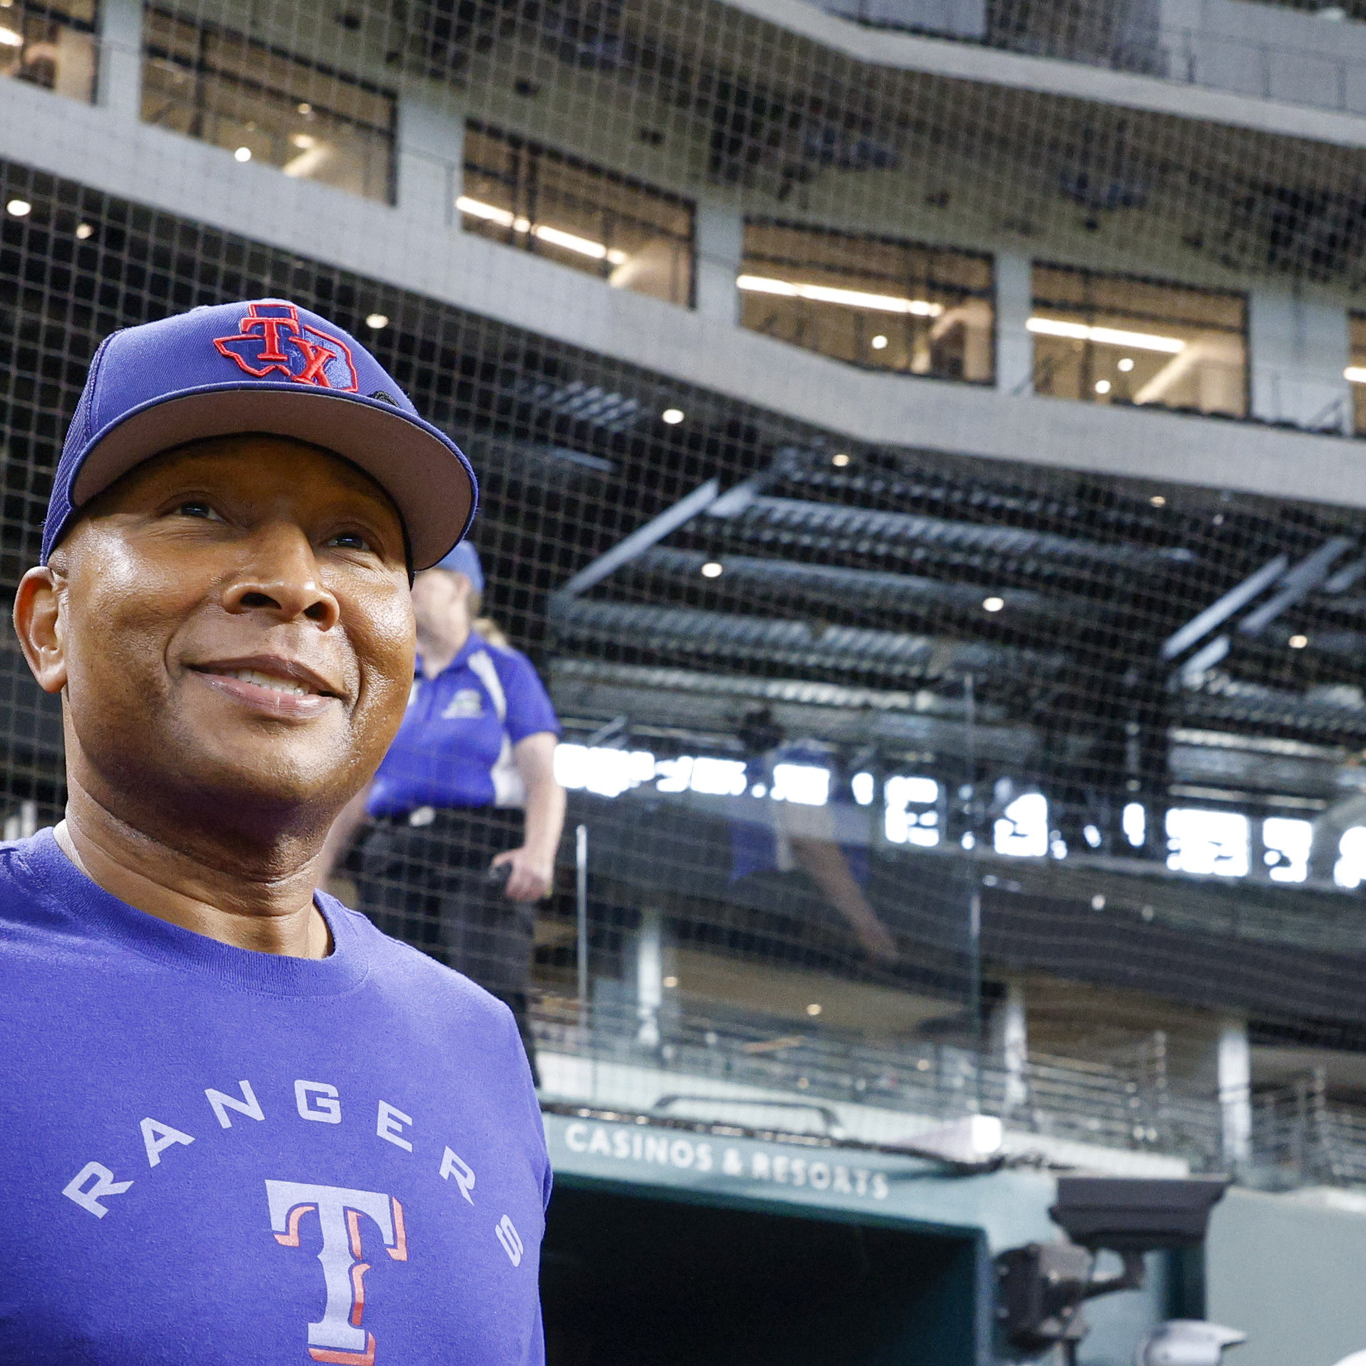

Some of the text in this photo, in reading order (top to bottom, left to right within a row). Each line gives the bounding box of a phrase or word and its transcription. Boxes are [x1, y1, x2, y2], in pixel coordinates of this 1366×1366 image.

[238, 316, 338, 388] TX
[62, 1079, 525, 1268] RANGERS
[565, 1123, 890, 1200] CASINOS & RESORTS
[264, 1179, 408, 1366] T
